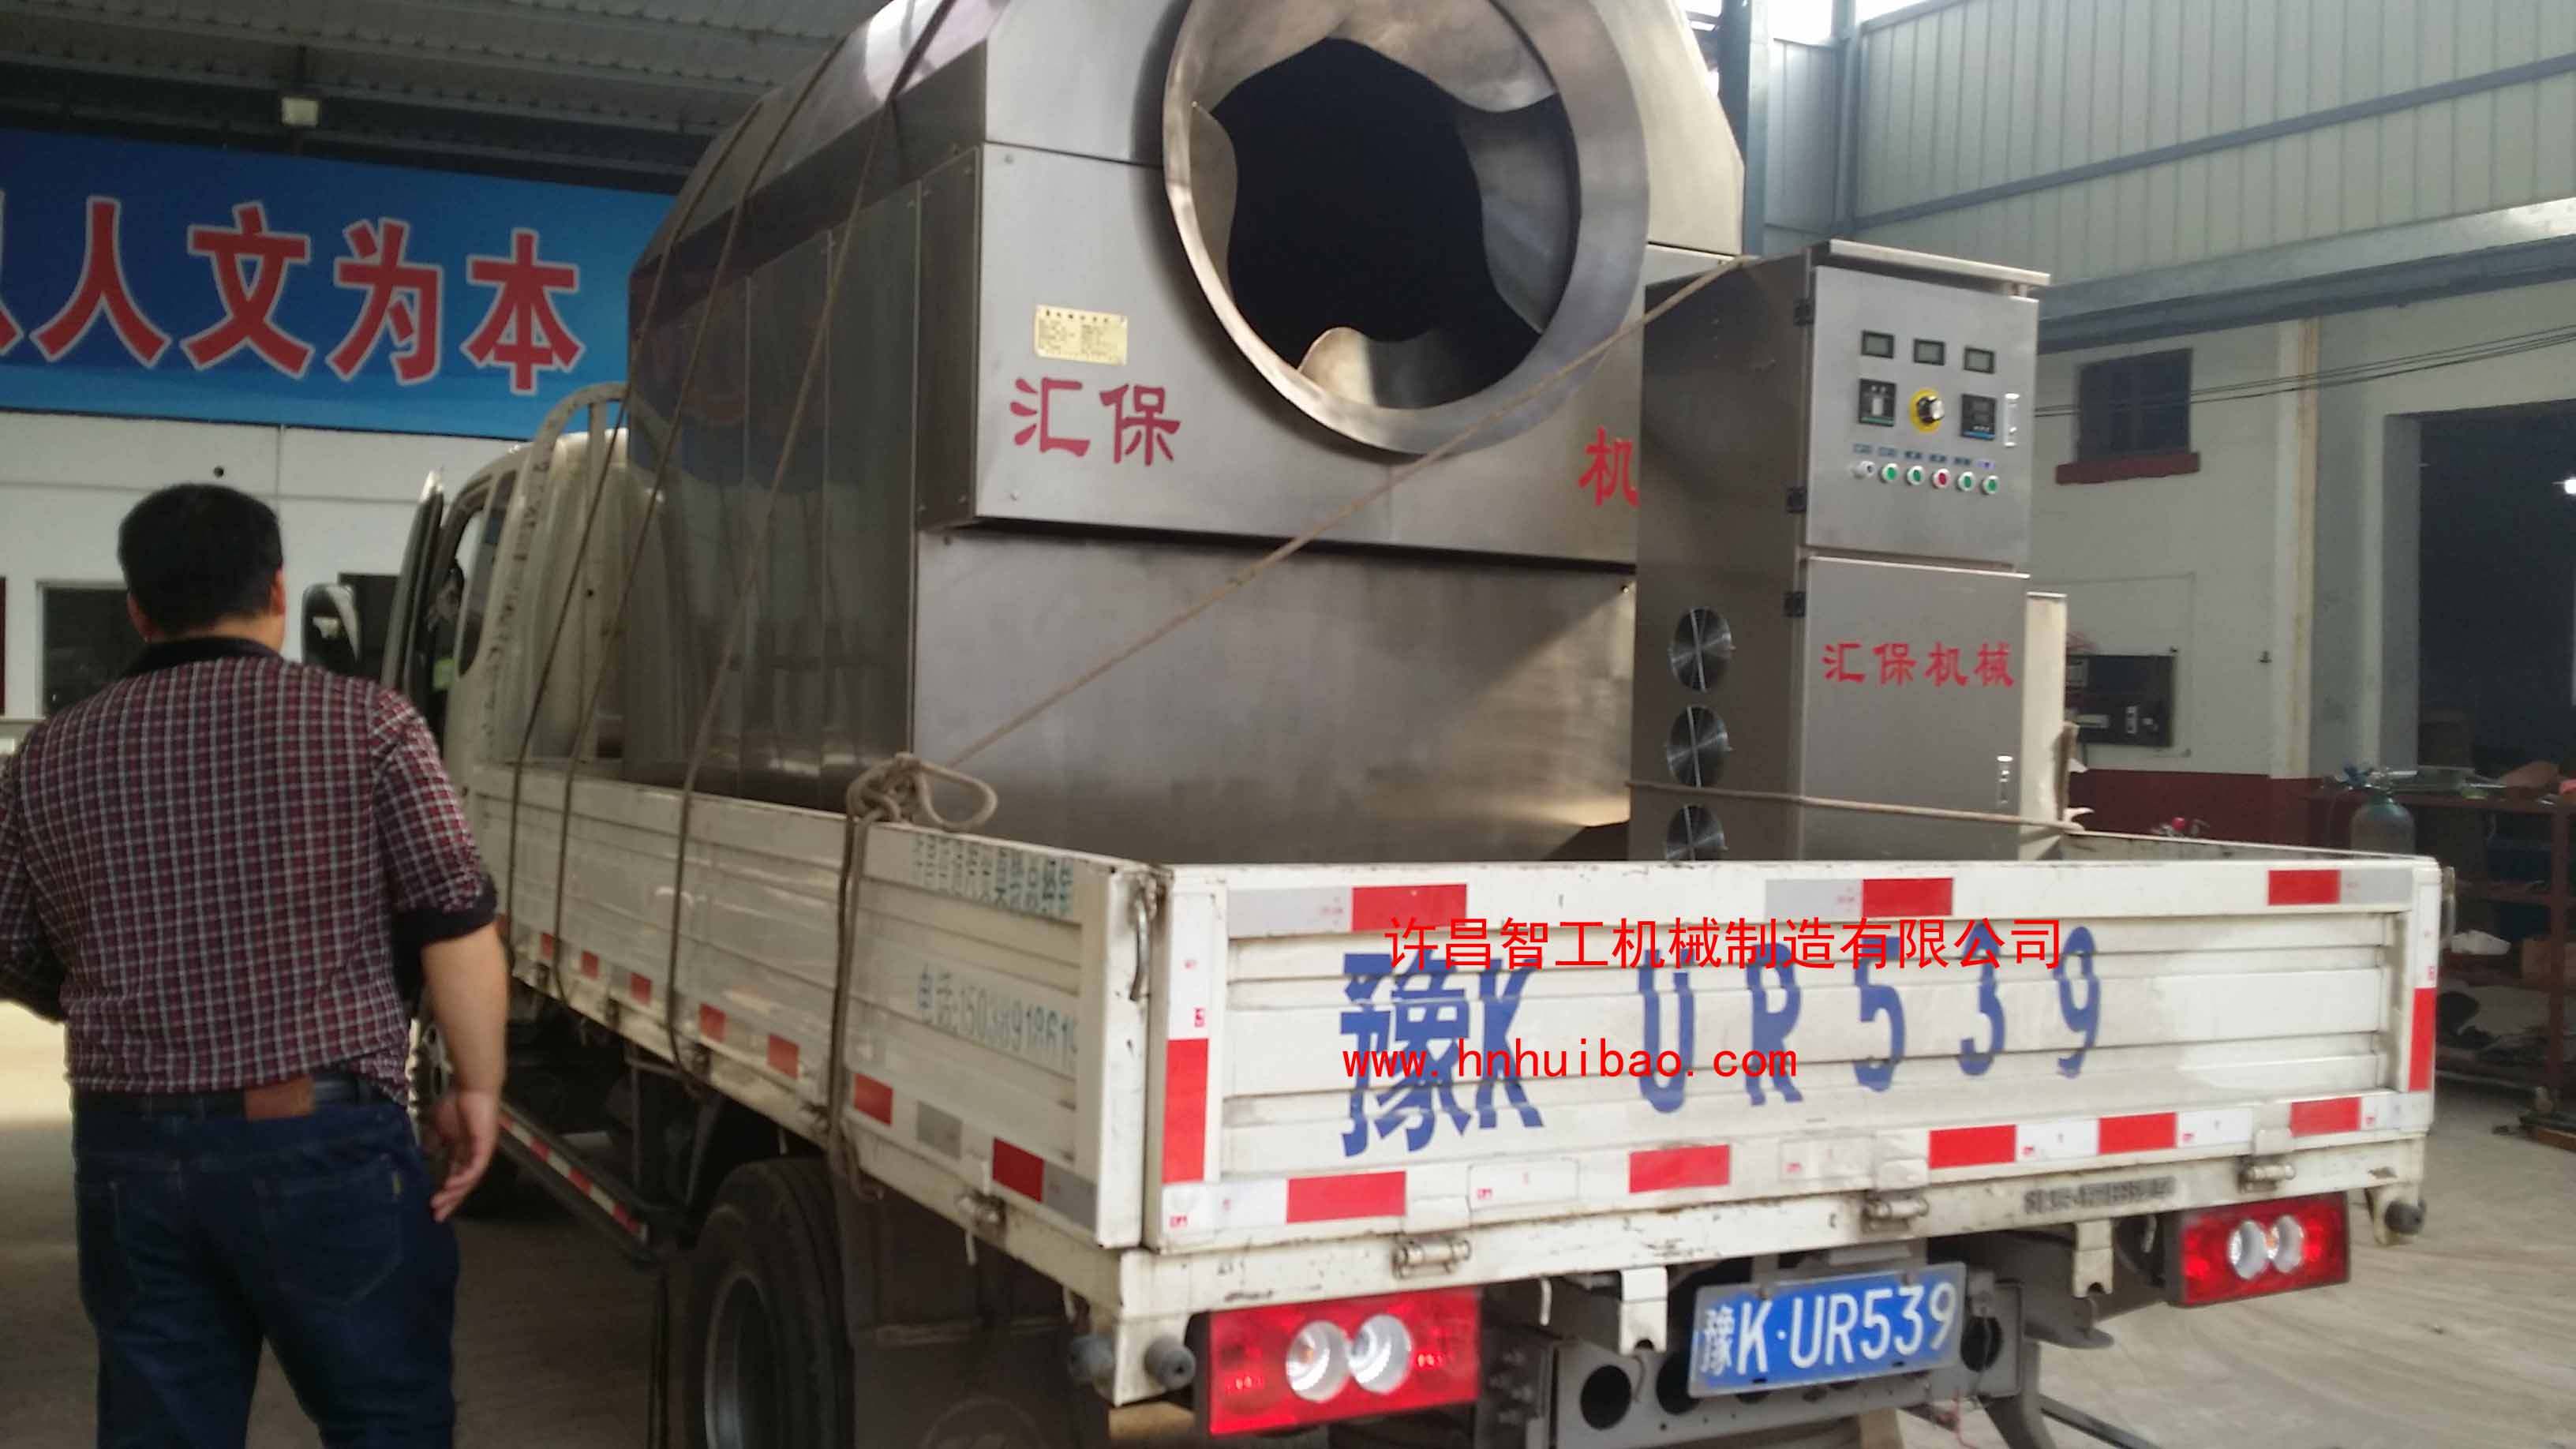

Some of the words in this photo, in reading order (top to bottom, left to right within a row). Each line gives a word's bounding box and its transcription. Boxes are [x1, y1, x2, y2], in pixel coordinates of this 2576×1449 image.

[0, 192, 585, 395] 人文为本
[1009, 376, 1181, 466] 汇保
[1578, 425, 1641, 507] 机
[1821, 640, 2015, 688] 汇保机械
